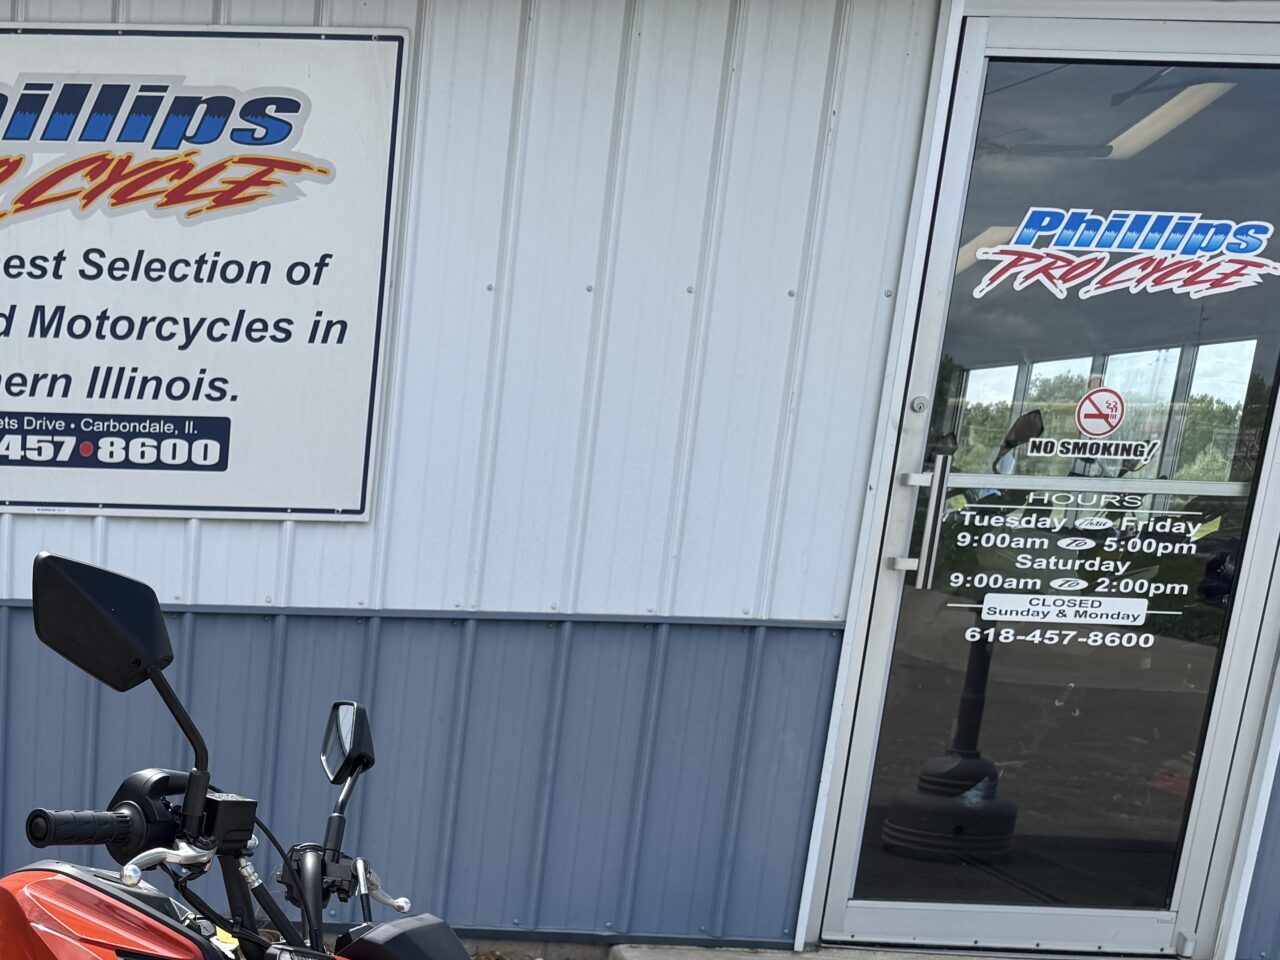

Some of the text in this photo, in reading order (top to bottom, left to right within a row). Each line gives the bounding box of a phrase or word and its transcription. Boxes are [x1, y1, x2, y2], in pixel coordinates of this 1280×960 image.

[1014, 209, 1271, 257] Phillips
[78, 248, 272, 284] Selection
[285, 253, 333, 286] of
[978, 249, 1279, 297] PRO CYCLE
[27, 305, 295, 351] Motorcycles
[308, 311, 348, 345] in
[86, 366, 238, 402] Illinois.
[23, 416, 66, 431] Drive
[80, 418, 179, 435] Carbondale,
[1029, 440, 1159, 462] NO SMOKING!
[1028, 492, 1143, 507] HOURS
[960, 511, 1068, 532] Tuesday
[1120, 517, 1202, 537] Friday
[956, 532, 1049, 550] 9:00am
[1103, 538, 1197, 557] 5:00pm
[1015, 554, 1131, 575] Saturday
[949, 572, 1042, 590] 9:00am
[1094, 578, 1189, 597] 2:00pm
[986, 607, 1141, 623] Sunday & Monday
[1028, 597, 1103, 609] CLOSED
[964, 628, 1155, 648] 618-457-8600
